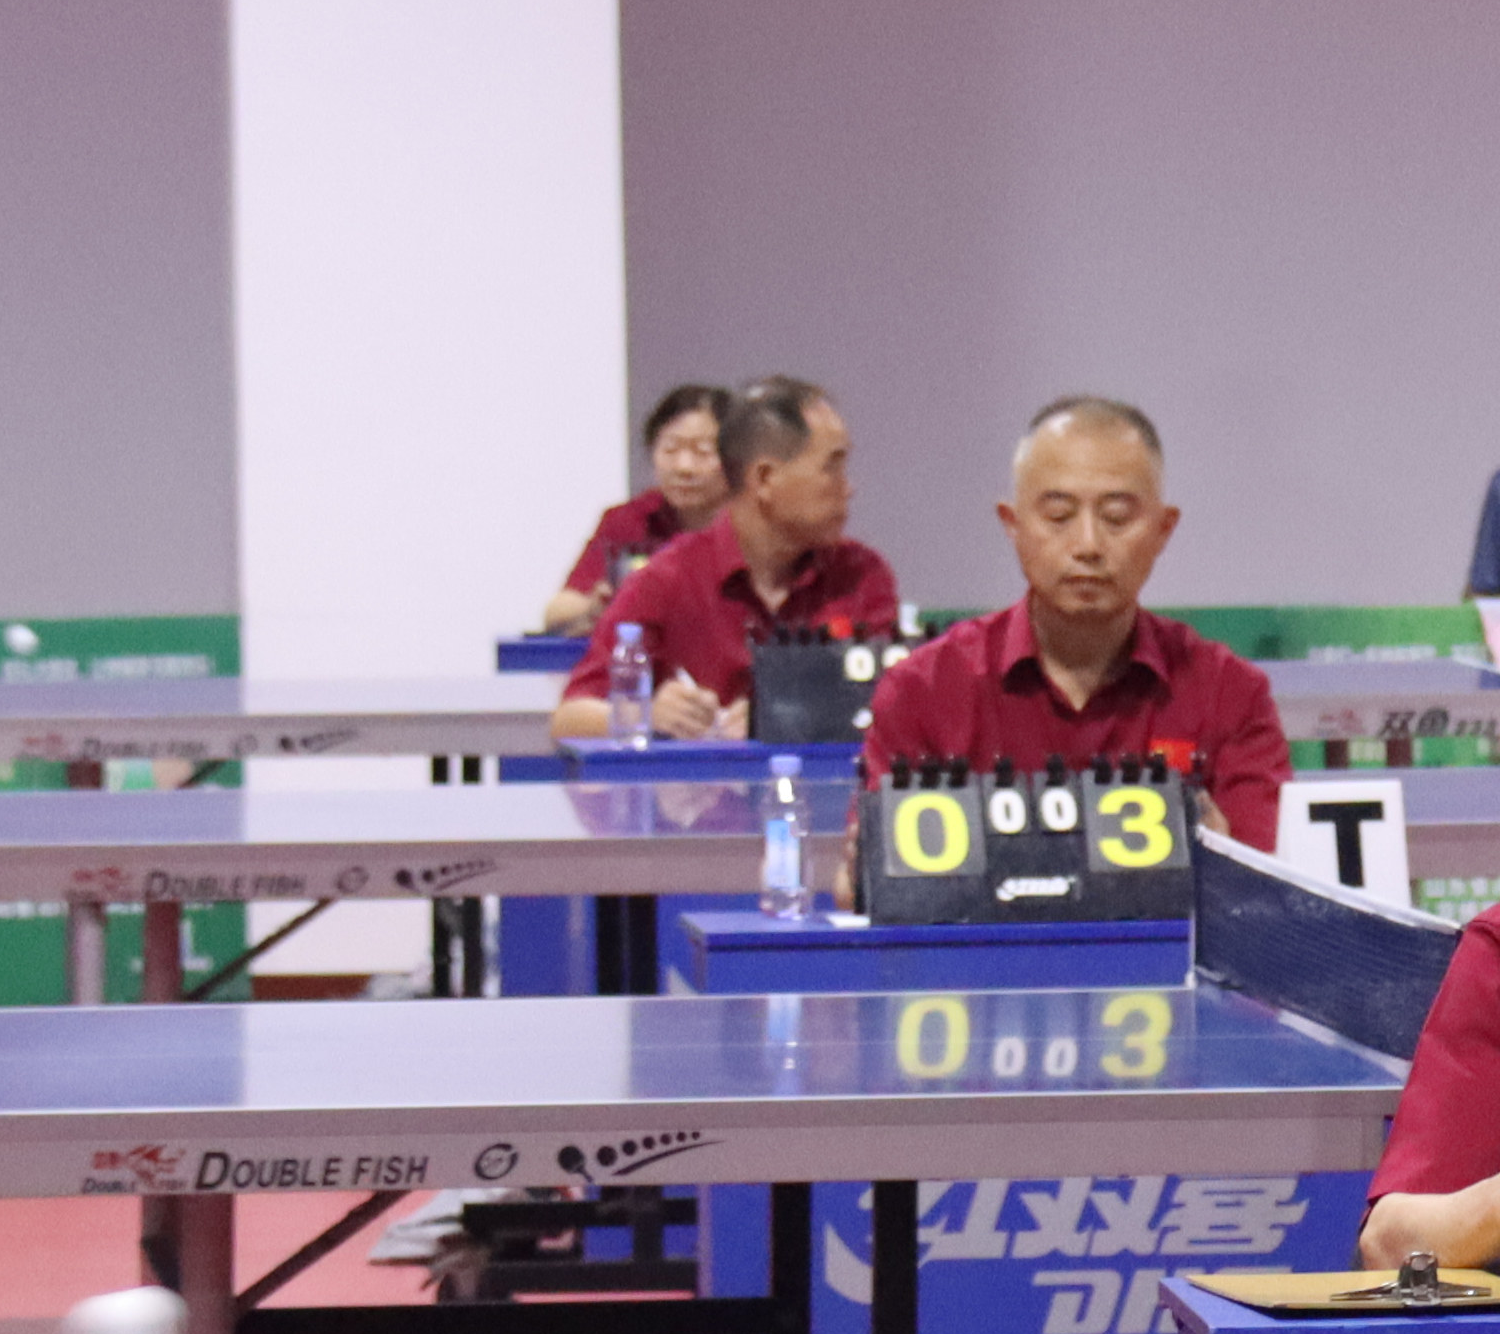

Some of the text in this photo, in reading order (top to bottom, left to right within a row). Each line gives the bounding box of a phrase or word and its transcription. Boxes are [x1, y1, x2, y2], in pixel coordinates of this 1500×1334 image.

[894, 793, 970, 873] 0
[1099, 785, 1174, 867] 3
[1308, 800, 1384, 887] T
[196, 1151, 430, 1191] DOUBLE FISH
